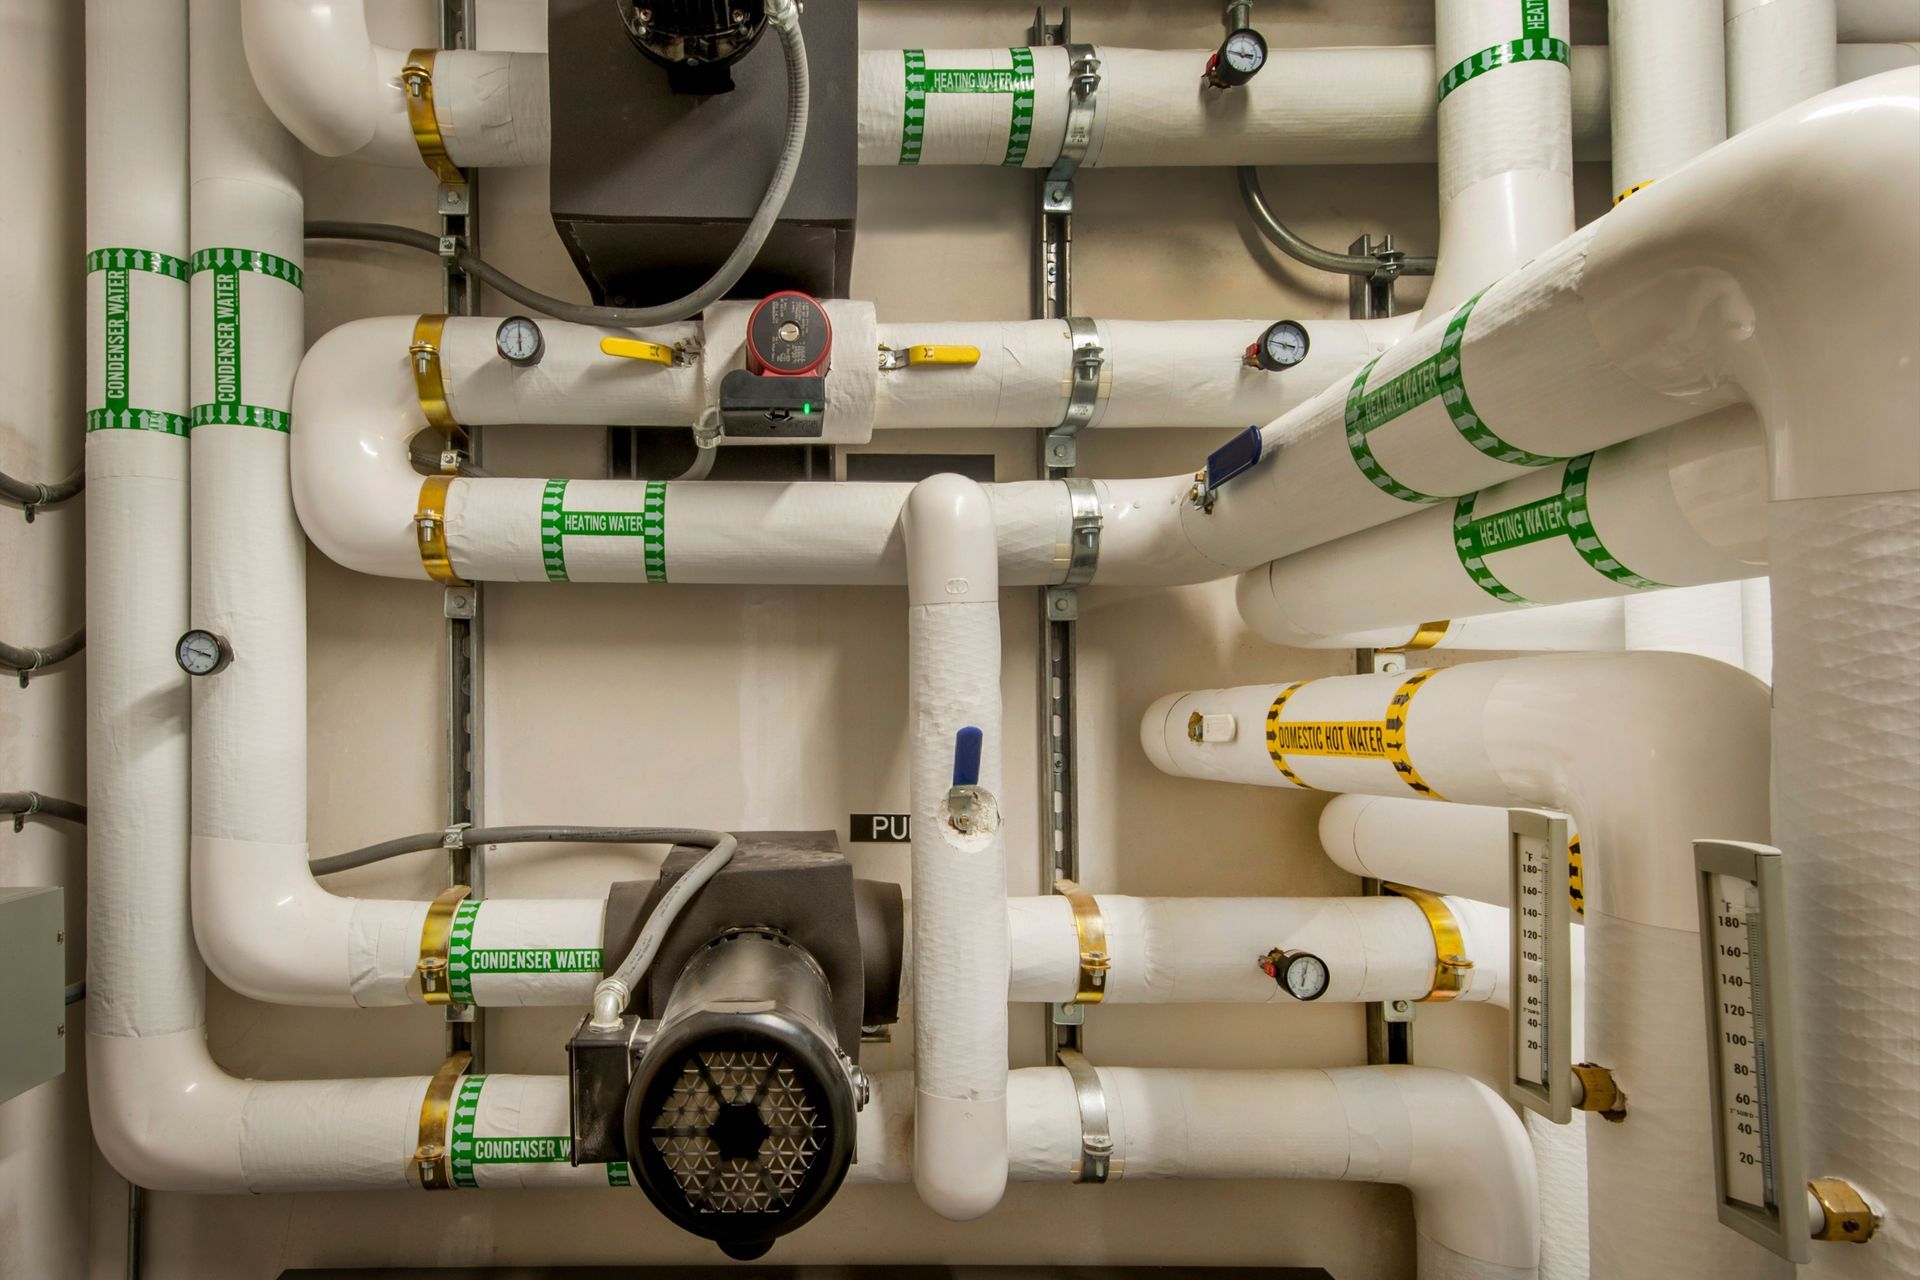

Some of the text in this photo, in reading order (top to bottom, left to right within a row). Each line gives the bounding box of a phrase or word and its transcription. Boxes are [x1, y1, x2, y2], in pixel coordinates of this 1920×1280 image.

[1526, 0, 1545, 29] HEAT
[933, 72, 1014, 91] HEATING WATER
[107, 270, 125, 399] CONDENSER WATER
[216, 273, 236, 402] CONDENSER WATER
[1365, 361, 1437, 424] HEATING WATER
[564, 514, 644, 532] HEATING WATER
[1480, 501, 1566, 548] HEATING WATER
[1279, 726, 1385, 753] DOMESTIC HOT WATER
[872, 816, 911, 840] PU
[1523, 864, 1538, 874] 180
[1523, 885, 1538, 896] 160
[1523, 907, 1538, 918] 140
[1718, 915, 1740, 928] 180
[1523, 929, 1538, 940] 120
[1523, 951, 1538, 961] 100
[1720, 945, 1741, 958] 160
[471, 950, 600, 970] CONDENSER WATER
[1527, 974, 1538, 984] 80
[1722, 973, 1743, 987] 140
[1527, 996, 1538, 1006] 60
[1724, 1003, 1745, 1017] 120
[1527, 1018, 1538, 1028] 40
[1527, 1040, 1538, 1050] 20
[1725, 1032, 1747, 1046] 100
[1734, 1063, 1749, 1076] 80
[1735, 1092, 1750, 1105] 60
[1737, 1122, 1752, 1135] 40
[475, 1140, 555, 1159] CONDENSER
[1739, 1152, 1754, 1165] 20
